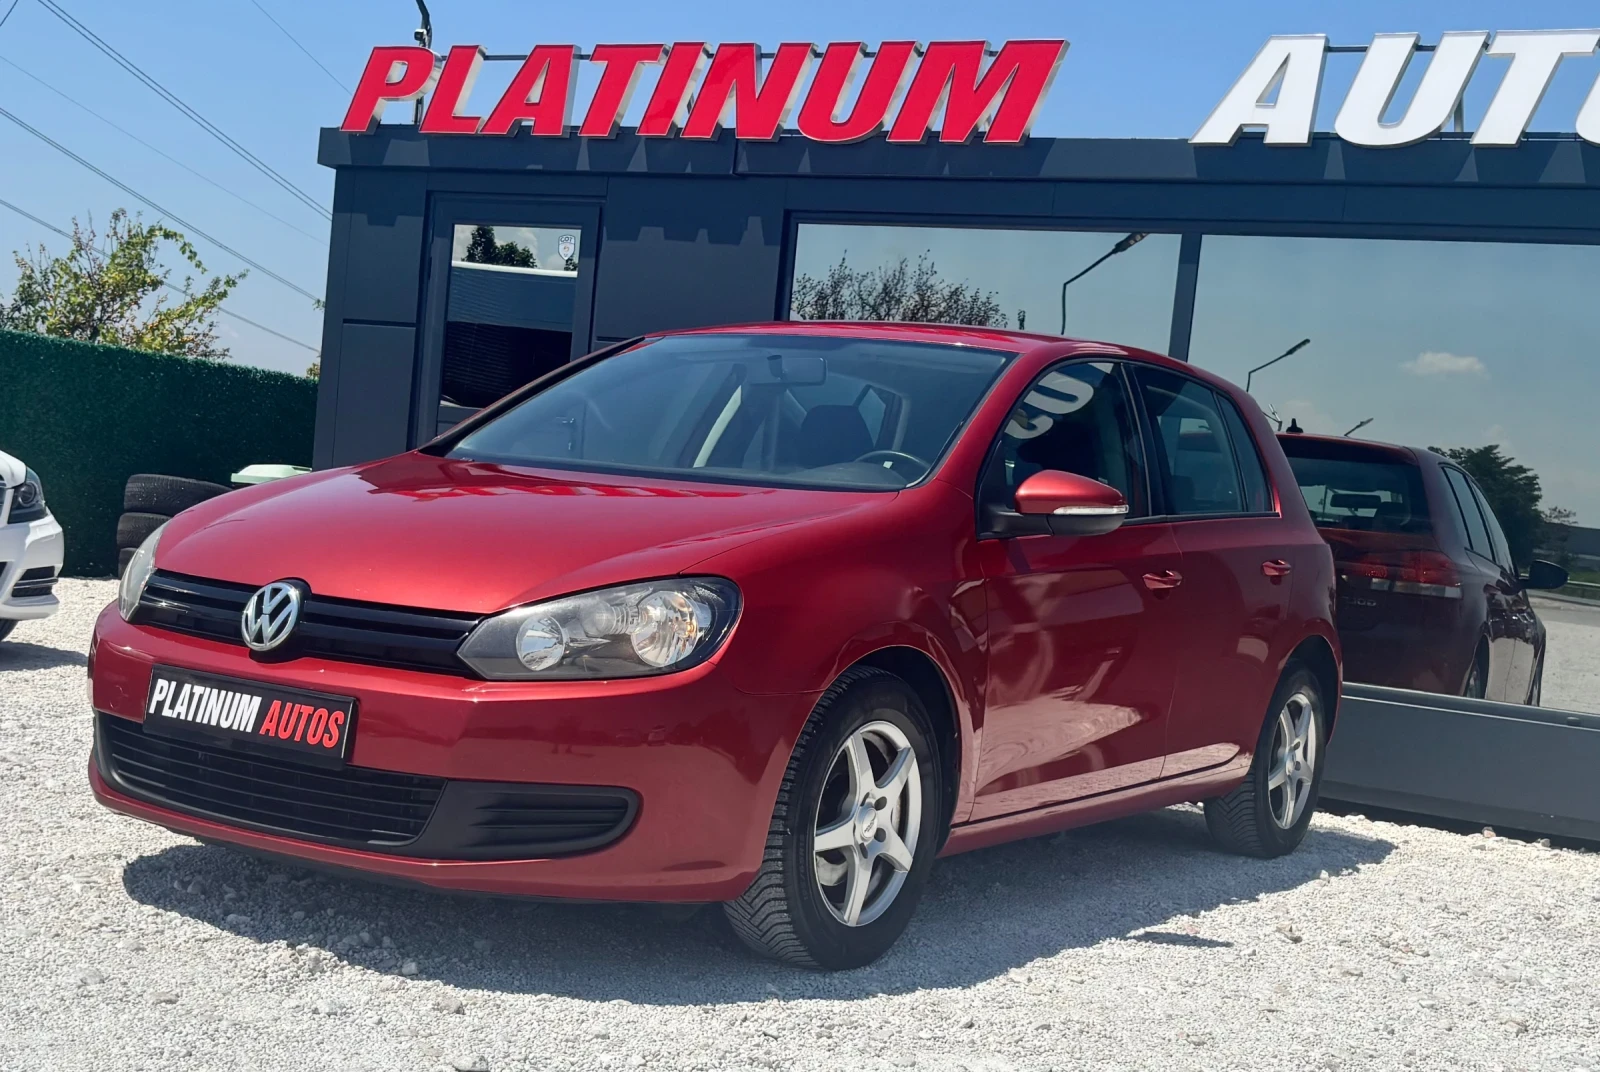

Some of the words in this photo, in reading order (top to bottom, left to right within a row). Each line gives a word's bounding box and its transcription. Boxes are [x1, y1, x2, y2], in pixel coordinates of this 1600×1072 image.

[339, 39, 1070, 145] PLATINUM
[241, 582, 299, 651] VW
[149, 678, 262, 733] PLATINUM
[259, 700, 345, 748] AUTOS
